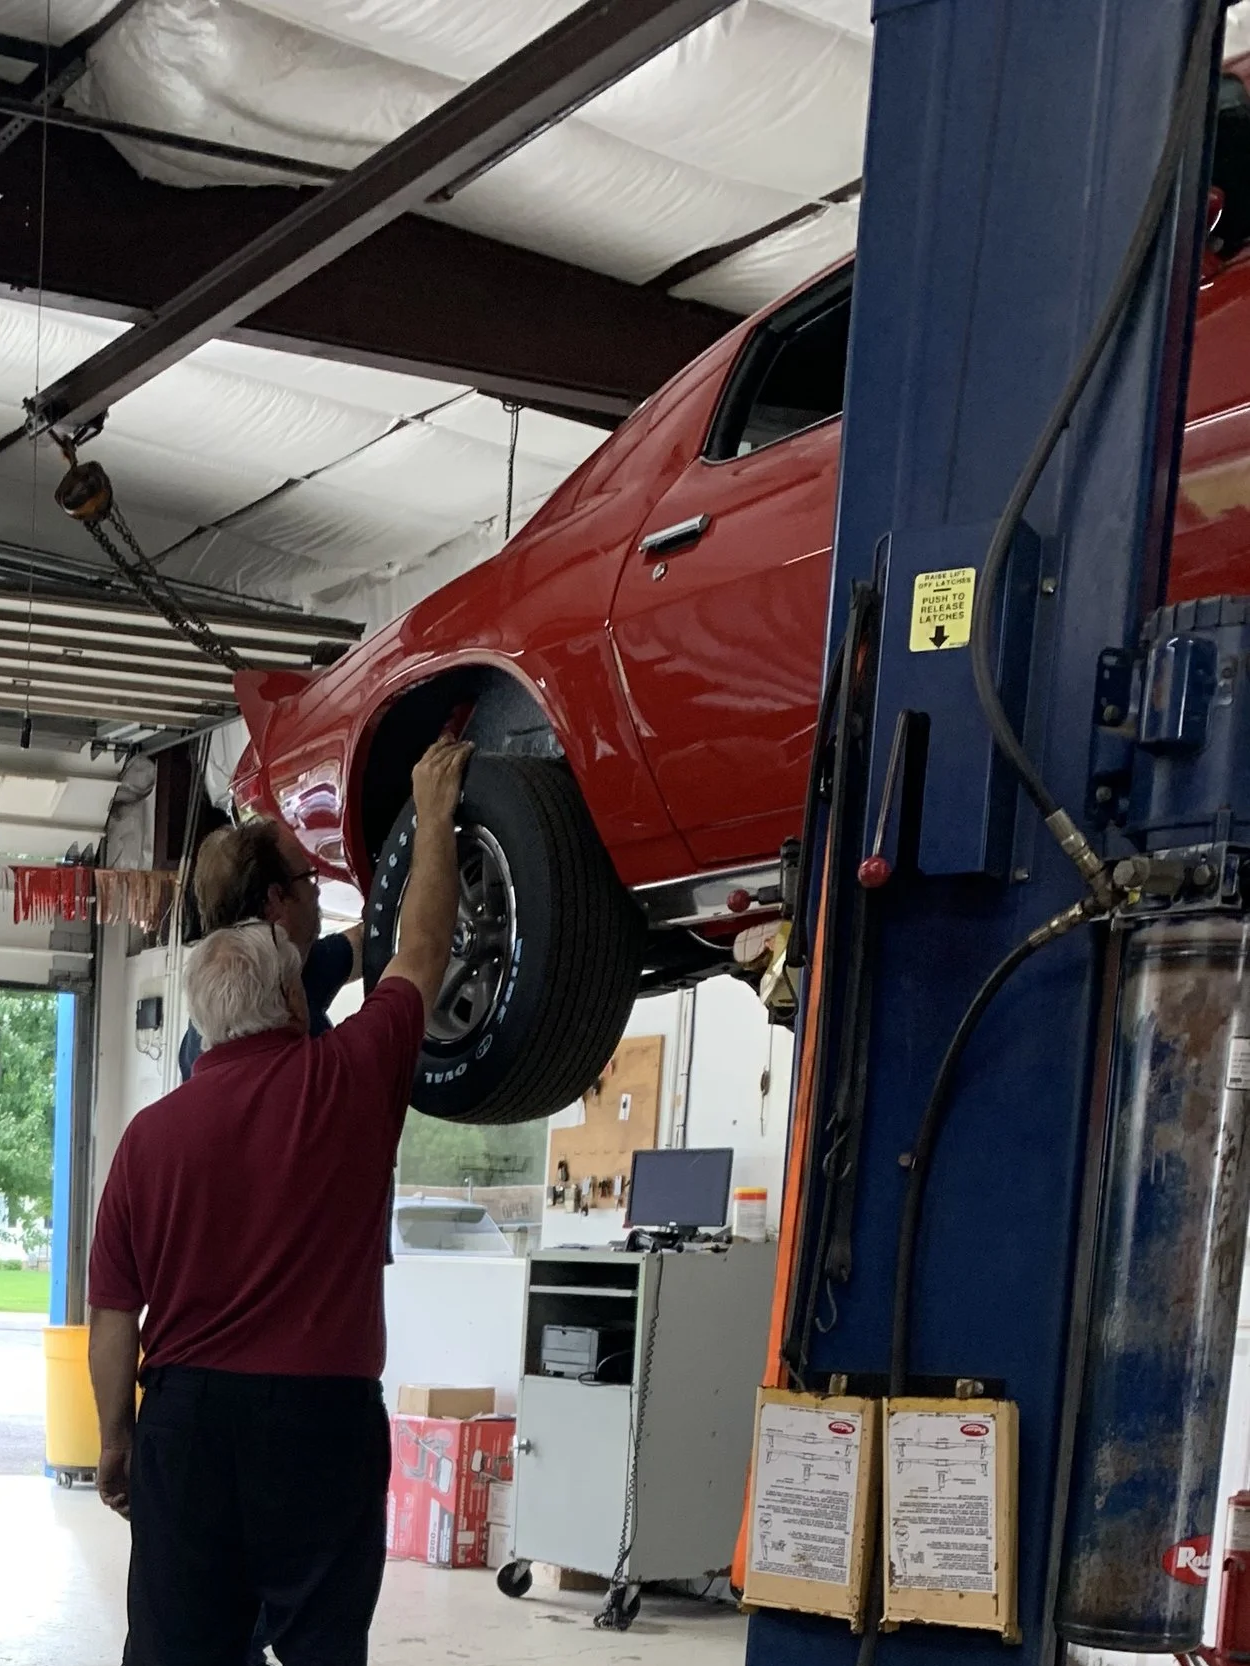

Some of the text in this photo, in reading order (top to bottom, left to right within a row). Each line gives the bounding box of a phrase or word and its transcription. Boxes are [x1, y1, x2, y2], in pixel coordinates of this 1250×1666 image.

[924, 570, 966, 581] RAISE LIFT
[935, 577, 971, 587] LATCHES
[922, 592, 965, 605] PUSH TO
[920, 602, 965, 614] RELEASE
[919, 611, 965, 624] LATCHES
[424, 1062, 468, 1084] OVAL
